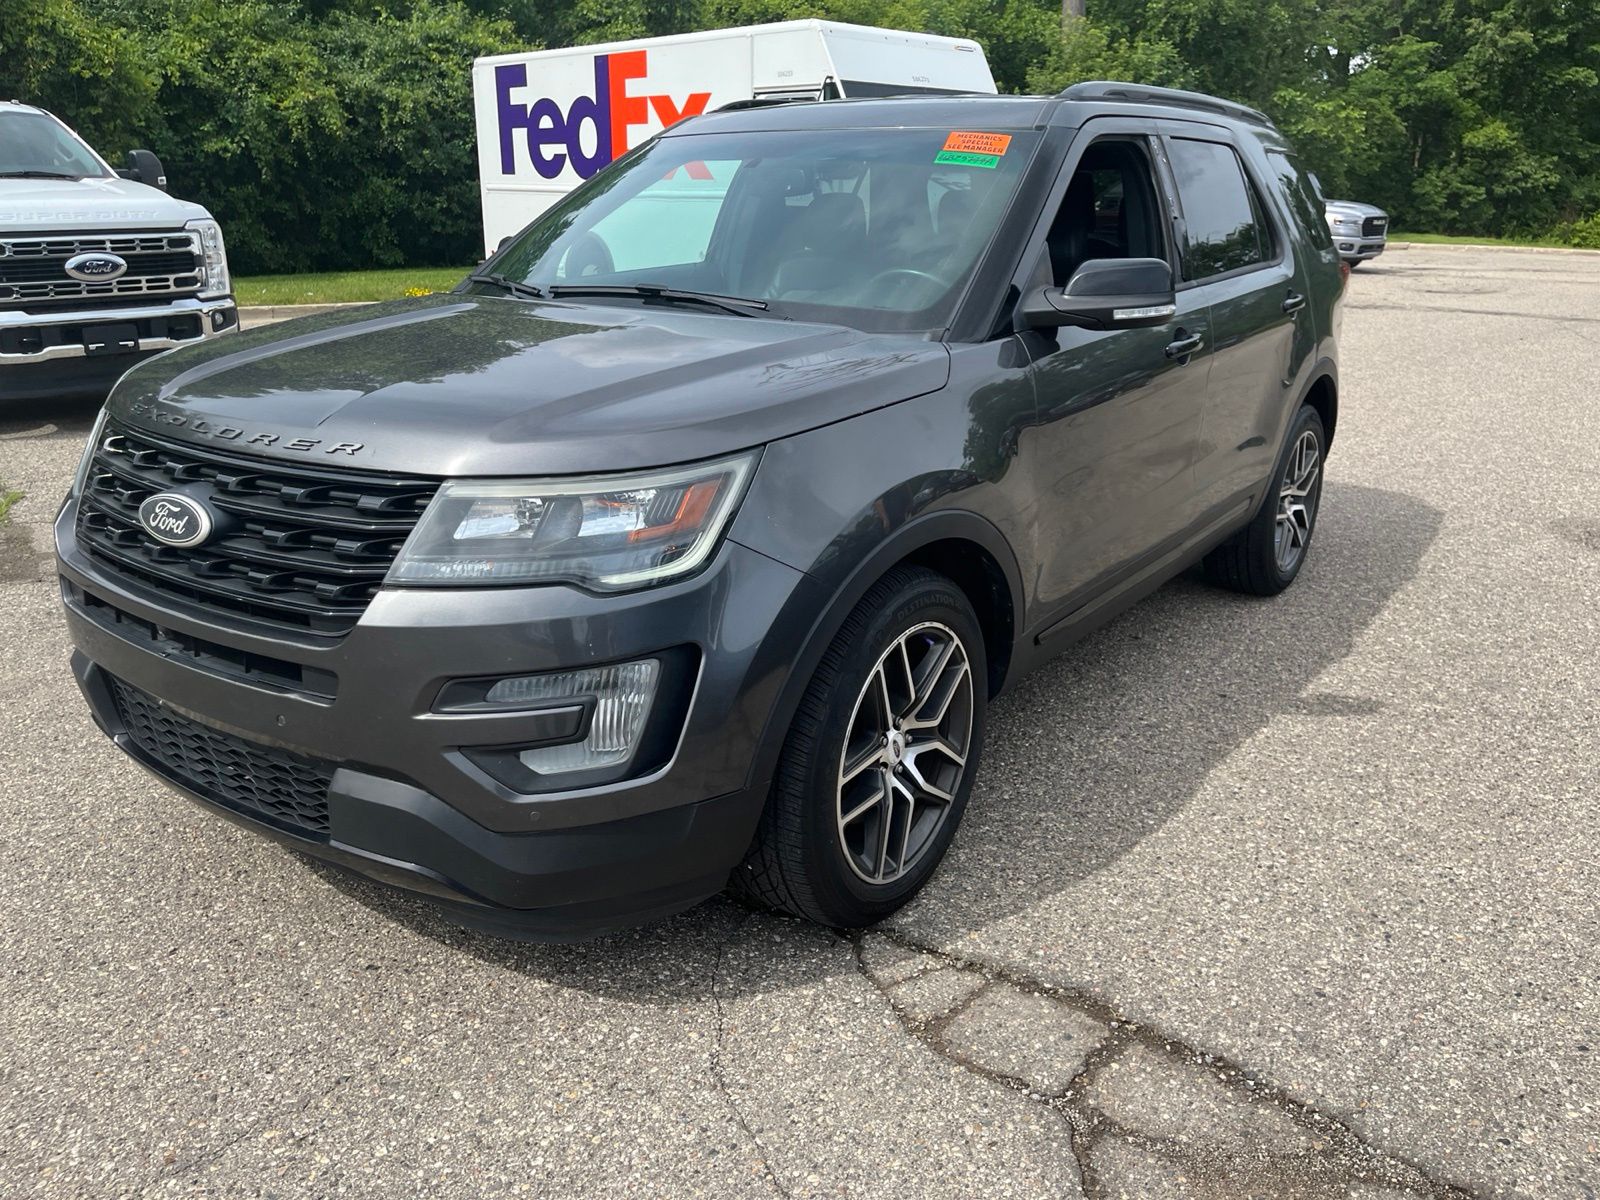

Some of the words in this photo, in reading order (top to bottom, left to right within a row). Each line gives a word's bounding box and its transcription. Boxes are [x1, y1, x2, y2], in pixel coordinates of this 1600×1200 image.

[494, 50, 714, 180] FedEx
[957, 133, 1003, 142] MECHANICS
[962, 144, 1004, 153] MANAGER
[95, 210, 160, 219] DUTY
[84, 260, 113, 274] Ford
[131, 404, 364, 455] EXPLORER
[150, 501, 188, 535] Ford
